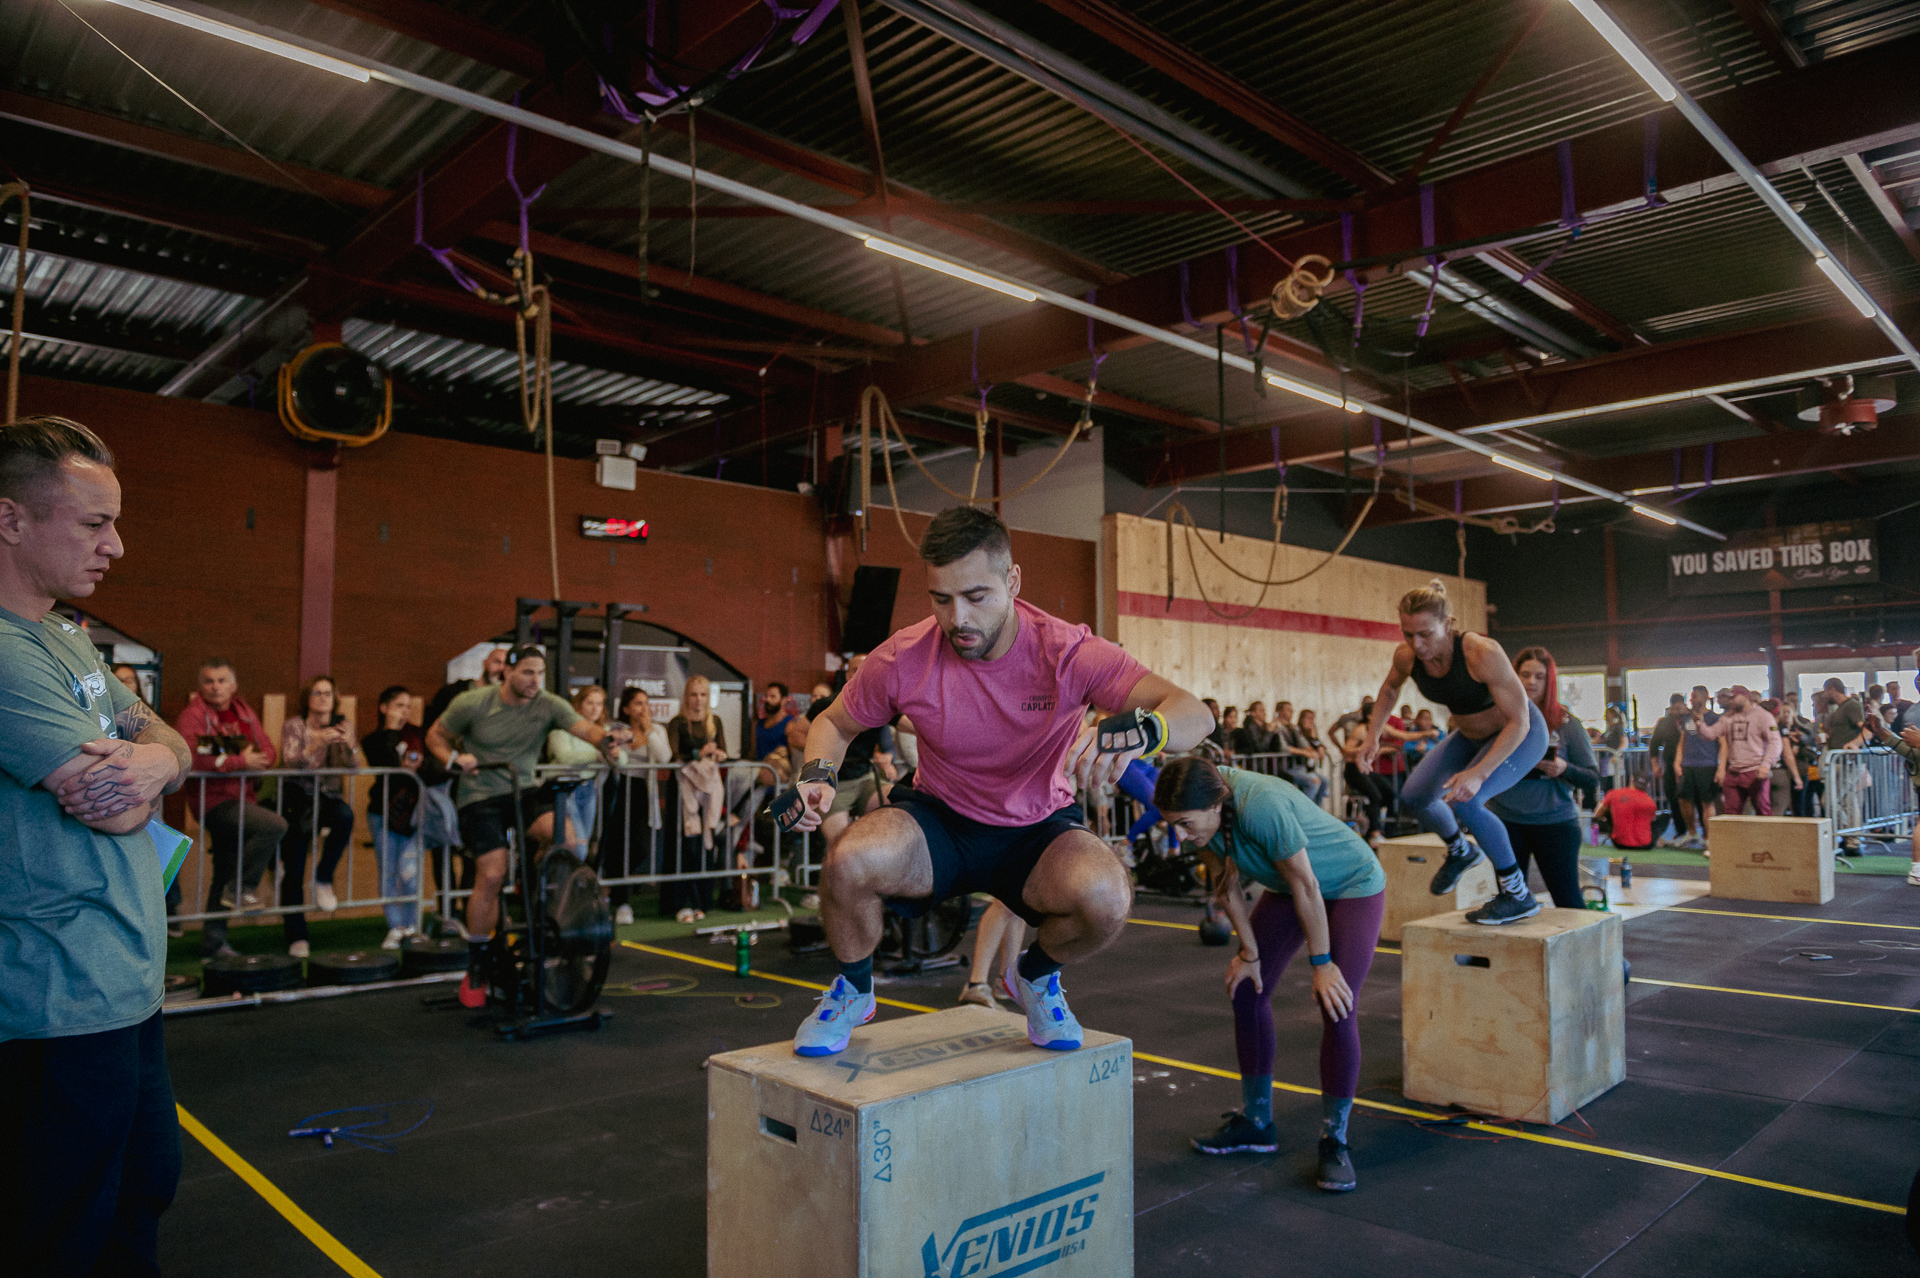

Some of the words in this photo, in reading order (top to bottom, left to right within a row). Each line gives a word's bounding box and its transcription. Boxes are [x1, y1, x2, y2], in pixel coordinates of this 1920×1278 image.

[1671, 553, 1708, 576] YOU
[1712, 548, 1773, 573] SAVED
[1779, 543, 1824, 568] THIS
[1829, 538, 1872, 563] BOX
[1058, 1238, 1086, 1260] USA
